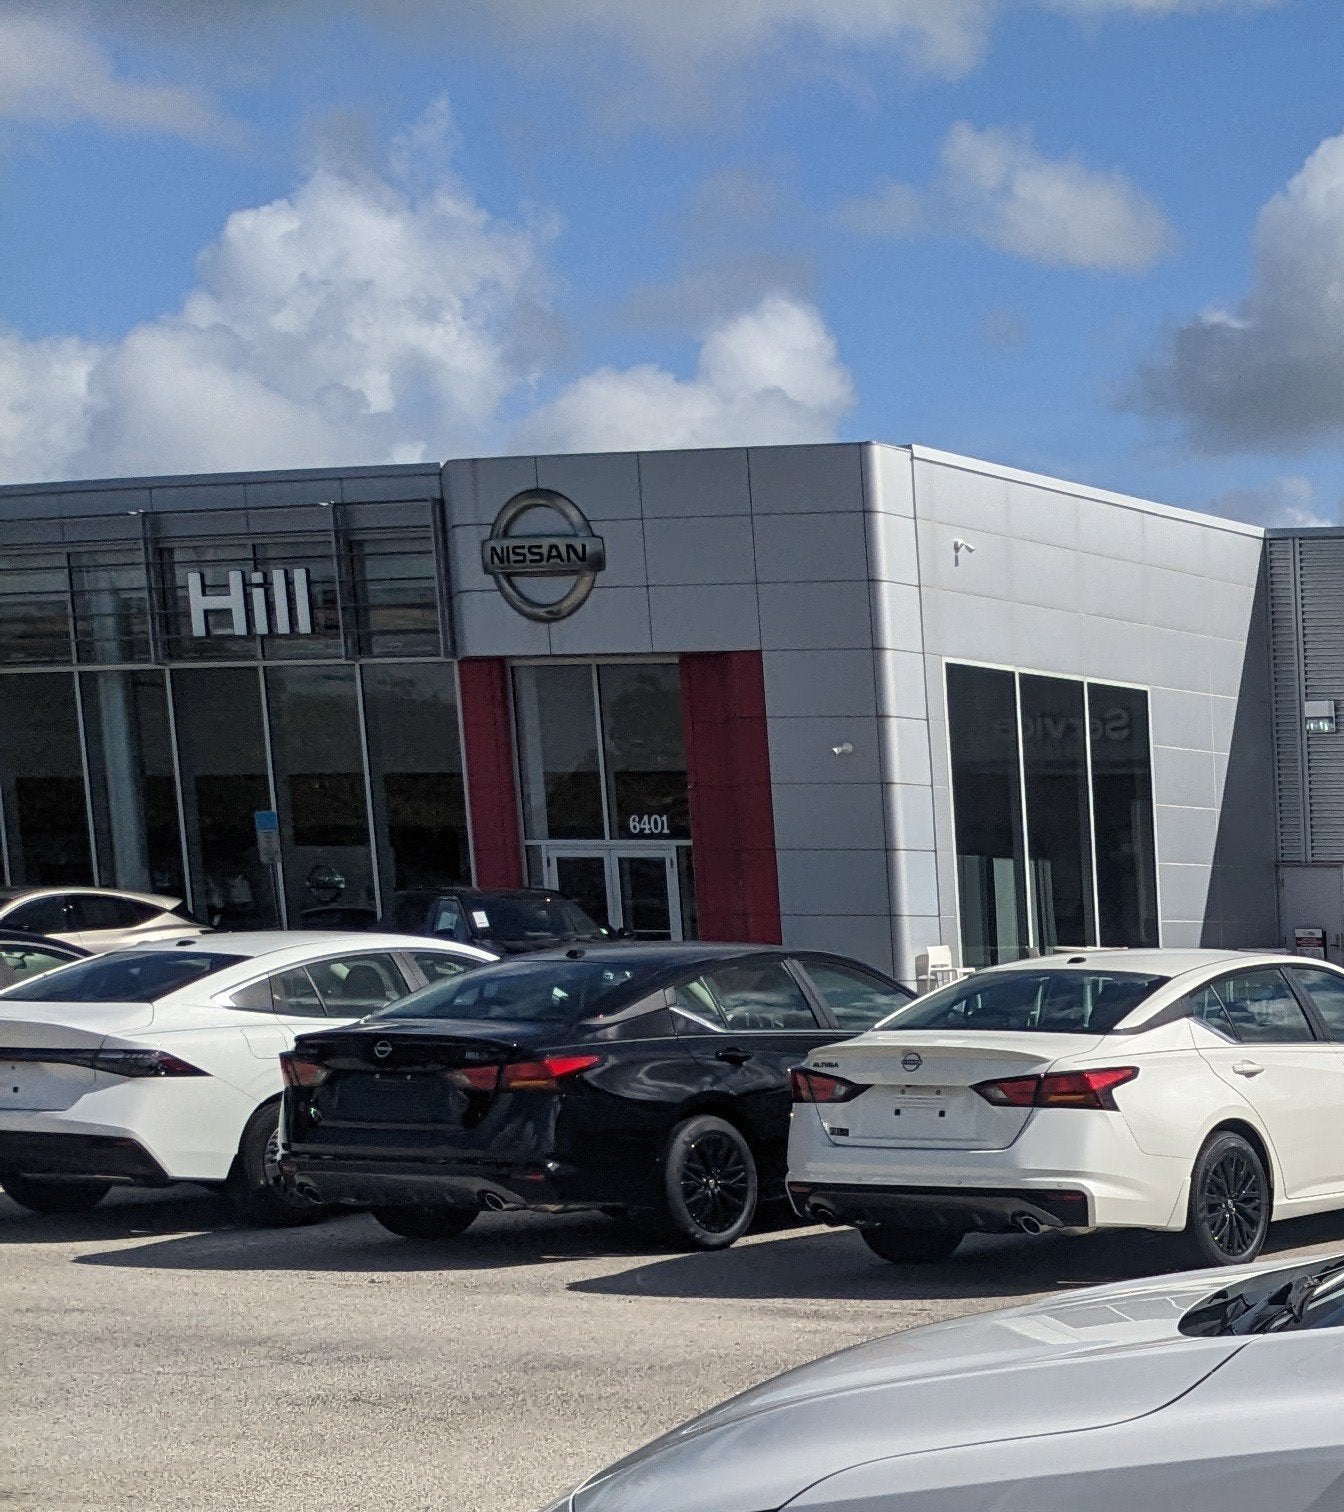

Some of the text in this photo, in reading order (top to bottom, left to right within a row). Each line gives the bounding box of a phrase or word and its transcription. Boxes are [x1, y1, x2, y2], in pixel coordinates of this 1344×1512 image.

[490, 543, 587, 565] NISSAN
[188, 568, 312, 637] Hill
[629, 814, 670, 834] 6401
